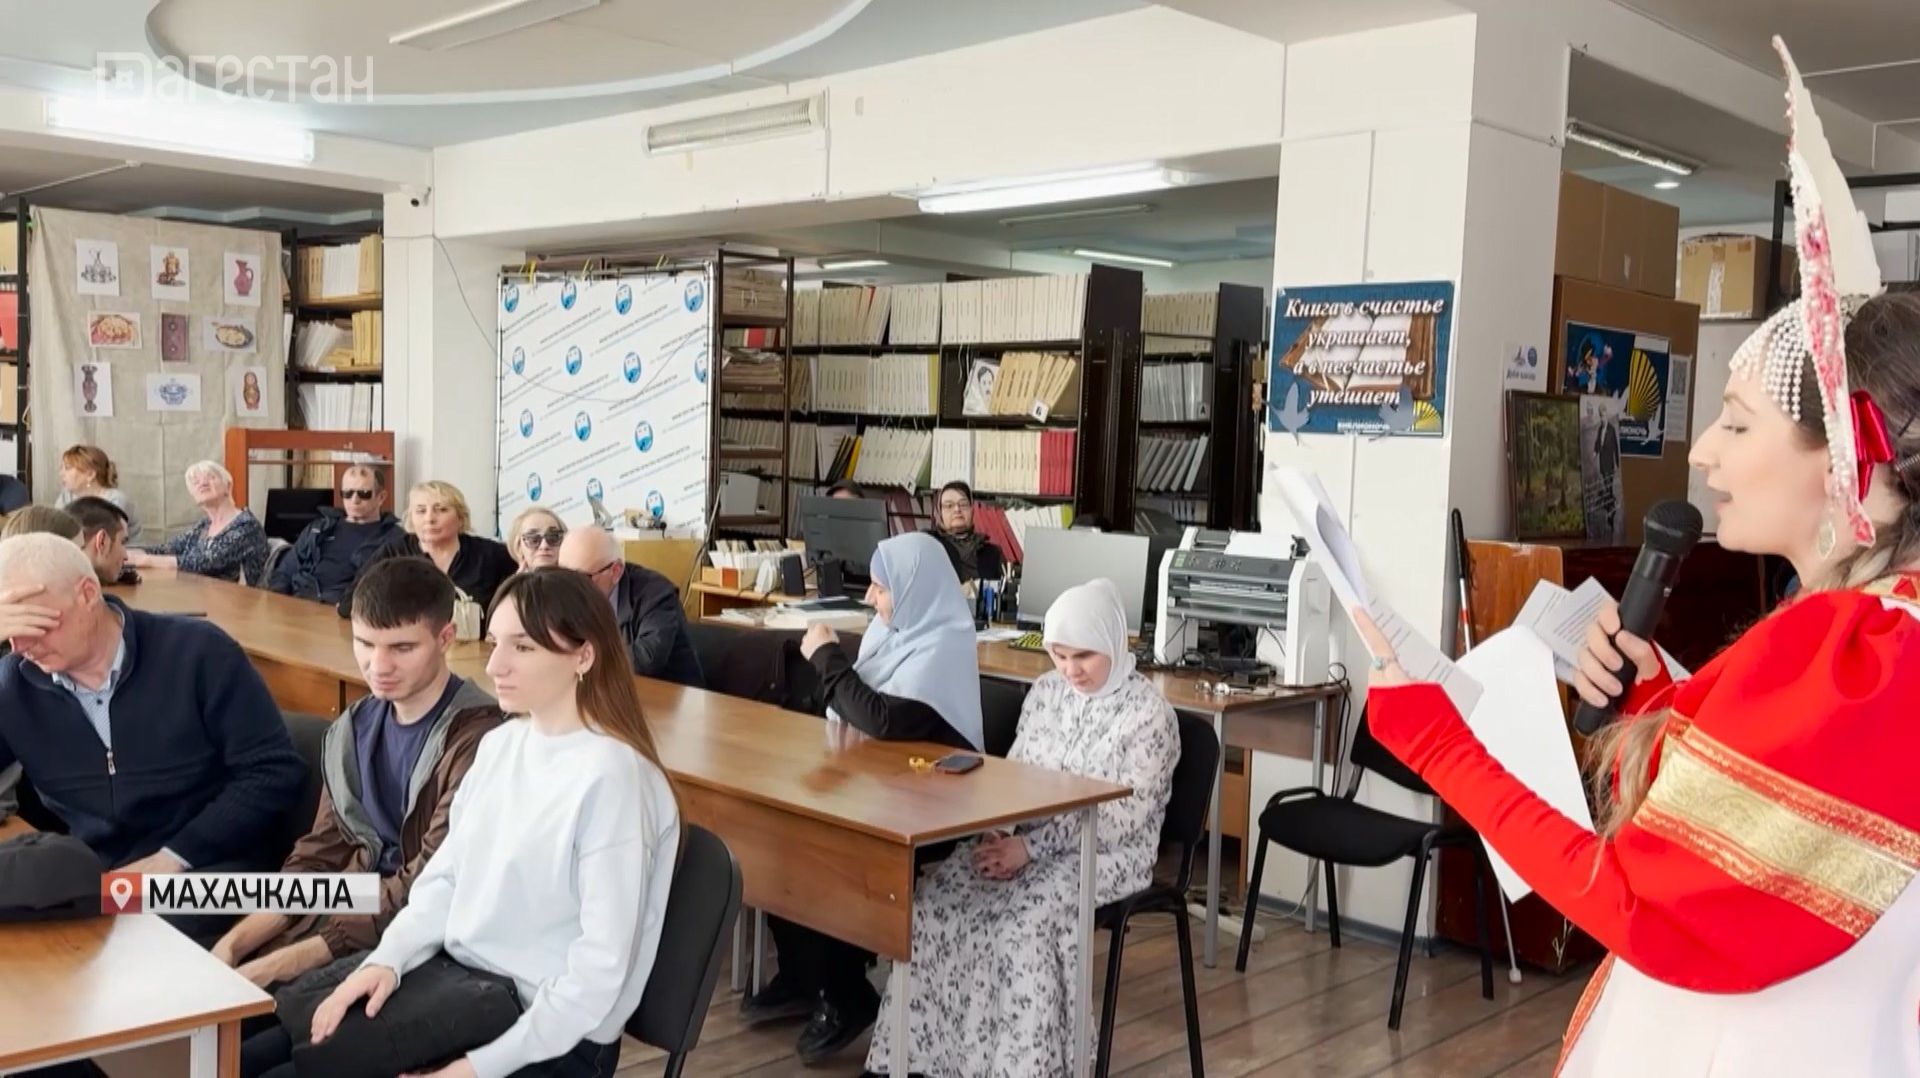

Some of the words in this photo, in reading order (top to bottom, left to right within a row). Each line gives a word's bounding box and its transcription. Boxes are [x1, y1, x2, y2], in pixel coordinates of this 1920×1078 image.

[1284, 297, 1342, 318] Книга
[1344, 301, 1355, 314] в
[1359, 298, 1445, 317] счастье
[1306, 330, 1411, 351] украшает,
[1292, 362, 1304, 374] а
[1308, 362, 1318, 374] в
[1323, 360, 1427, 375] несчастье
[1306, 389, 1401, 407] утешает
